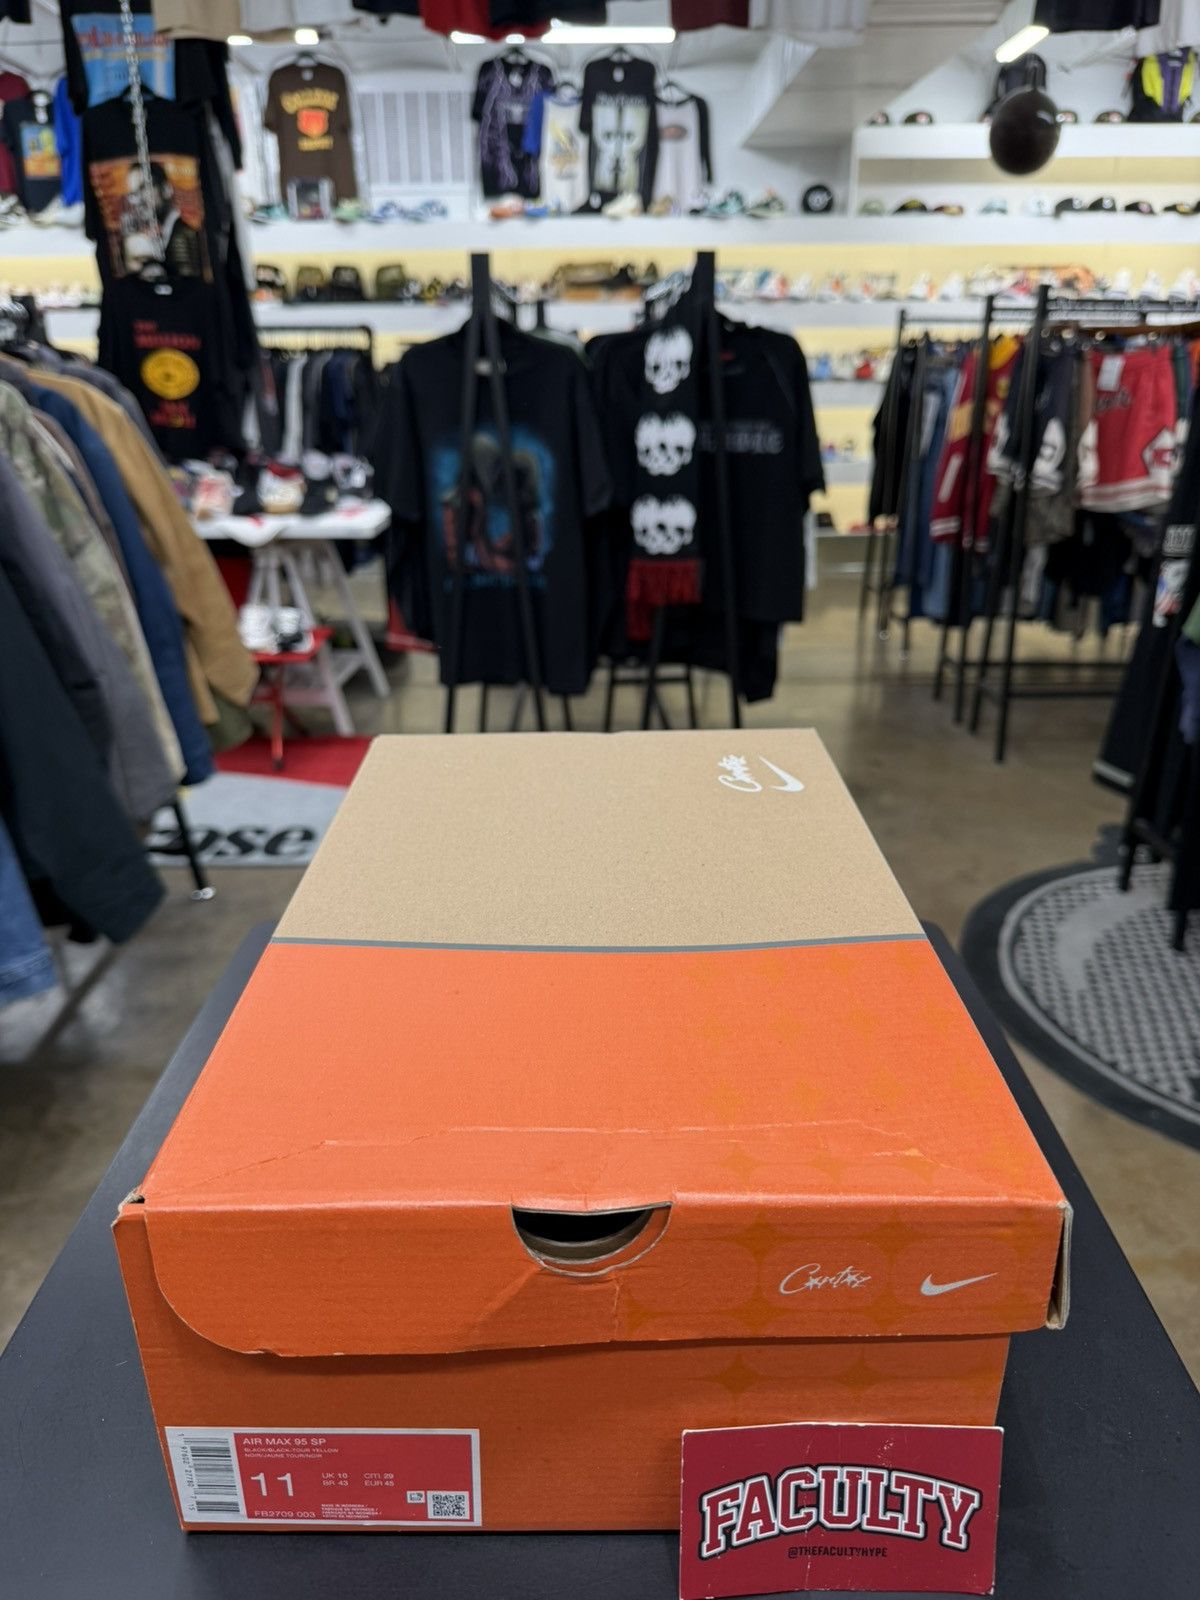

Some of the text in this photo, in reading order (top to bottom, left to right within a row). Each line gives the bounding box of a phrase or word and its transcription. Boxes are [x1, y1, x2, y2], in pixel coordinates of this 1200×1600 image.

[243, 1437, 327, 1446] AIR MAX 95 SP
[250, 1472, 294, 1497] 11
[699, 1462, 983, 1559] FACULTY
[788, 1546, 888, 1559] @THEFACULTYHYPE
